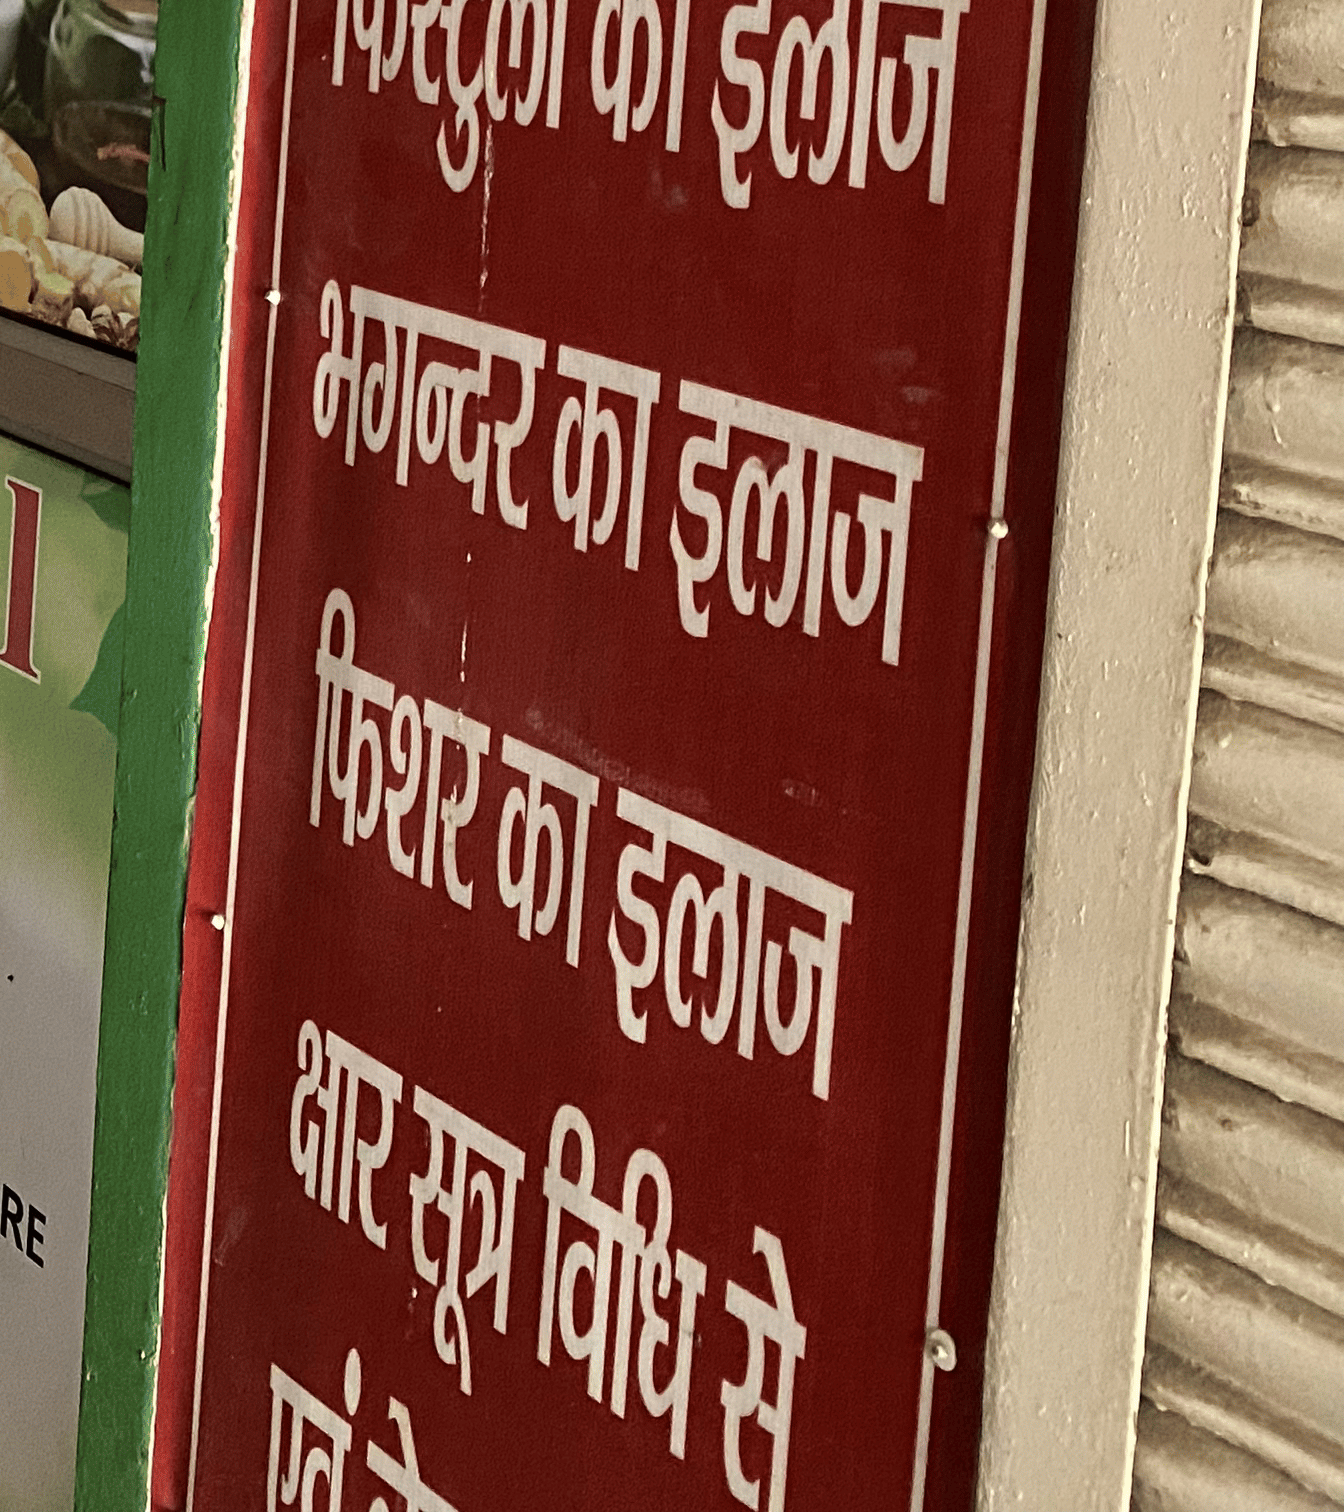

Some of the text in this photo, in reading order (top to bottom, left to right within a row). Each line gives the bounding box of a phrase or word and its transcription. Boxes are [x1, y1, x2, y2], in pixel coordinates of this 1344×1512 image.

[312, 279, 925, 666] भगन्दर का इलाज
[308, 588, 854, 1101] फिशर का इलाज
[289, 1019, 807, 1511] क्षार सूत्र विधि से
